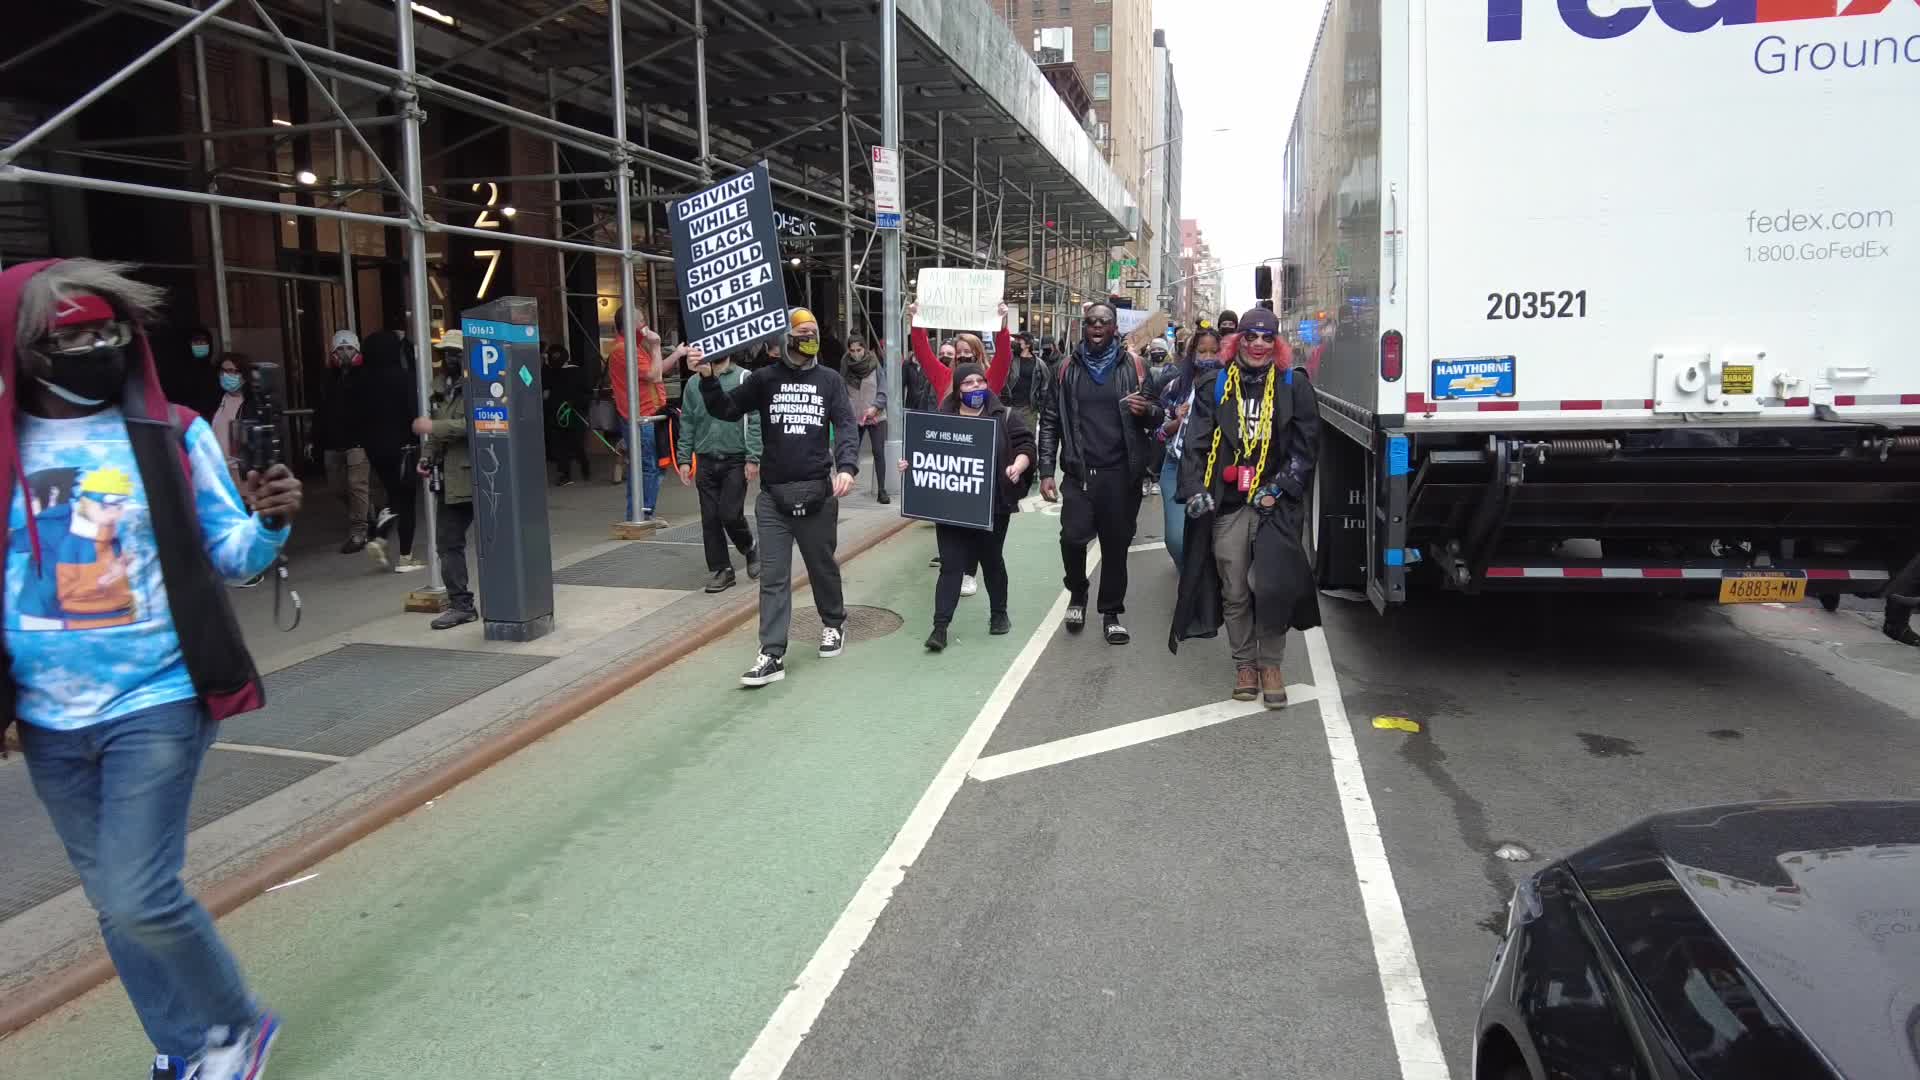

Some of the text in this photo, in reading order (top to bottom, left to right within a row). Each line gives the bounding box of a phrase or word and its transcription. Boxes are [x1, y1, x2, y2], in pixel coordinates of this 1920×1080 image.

[679, 175, 754, 218] DRIVING
[690, 201, 747, 236] WHILE
[1747, 208, 1893, 233] fedex.com
[692, 222, 752, 260] BLACK
[1746, 240, 1889, 262] 1.800.GoFedEx
[689, 244, 761, 285] SHOULD
[688, 266, 771, 311] NOT BE A
[924, 287, 993, 305] DAUNTE
[703, 293, 762, 329] DEATH
[1487, 290, 1586, 320] 203521
[468, 326, 495, 335] 101613
[691, 311, 785, 354] SENTENCE
[482, 345, 499, 375] P
[1436, 362, 1512, 375] HAWTHORNE
[772, 393, 824, 406] SHOULD BE
[780, 383, 817, 394] RACISM
[769, 404, 825, 416] PUNISHABLE
[770, 414, 823, 426] BY FEDERAL
[784, 424, 807, 434] LAW.
[925, 430, 973, 443] SAY HIS NAME
[912, 451, 985, 476] DAUNTE
[912, 469, 985, 495] WRIGHT
